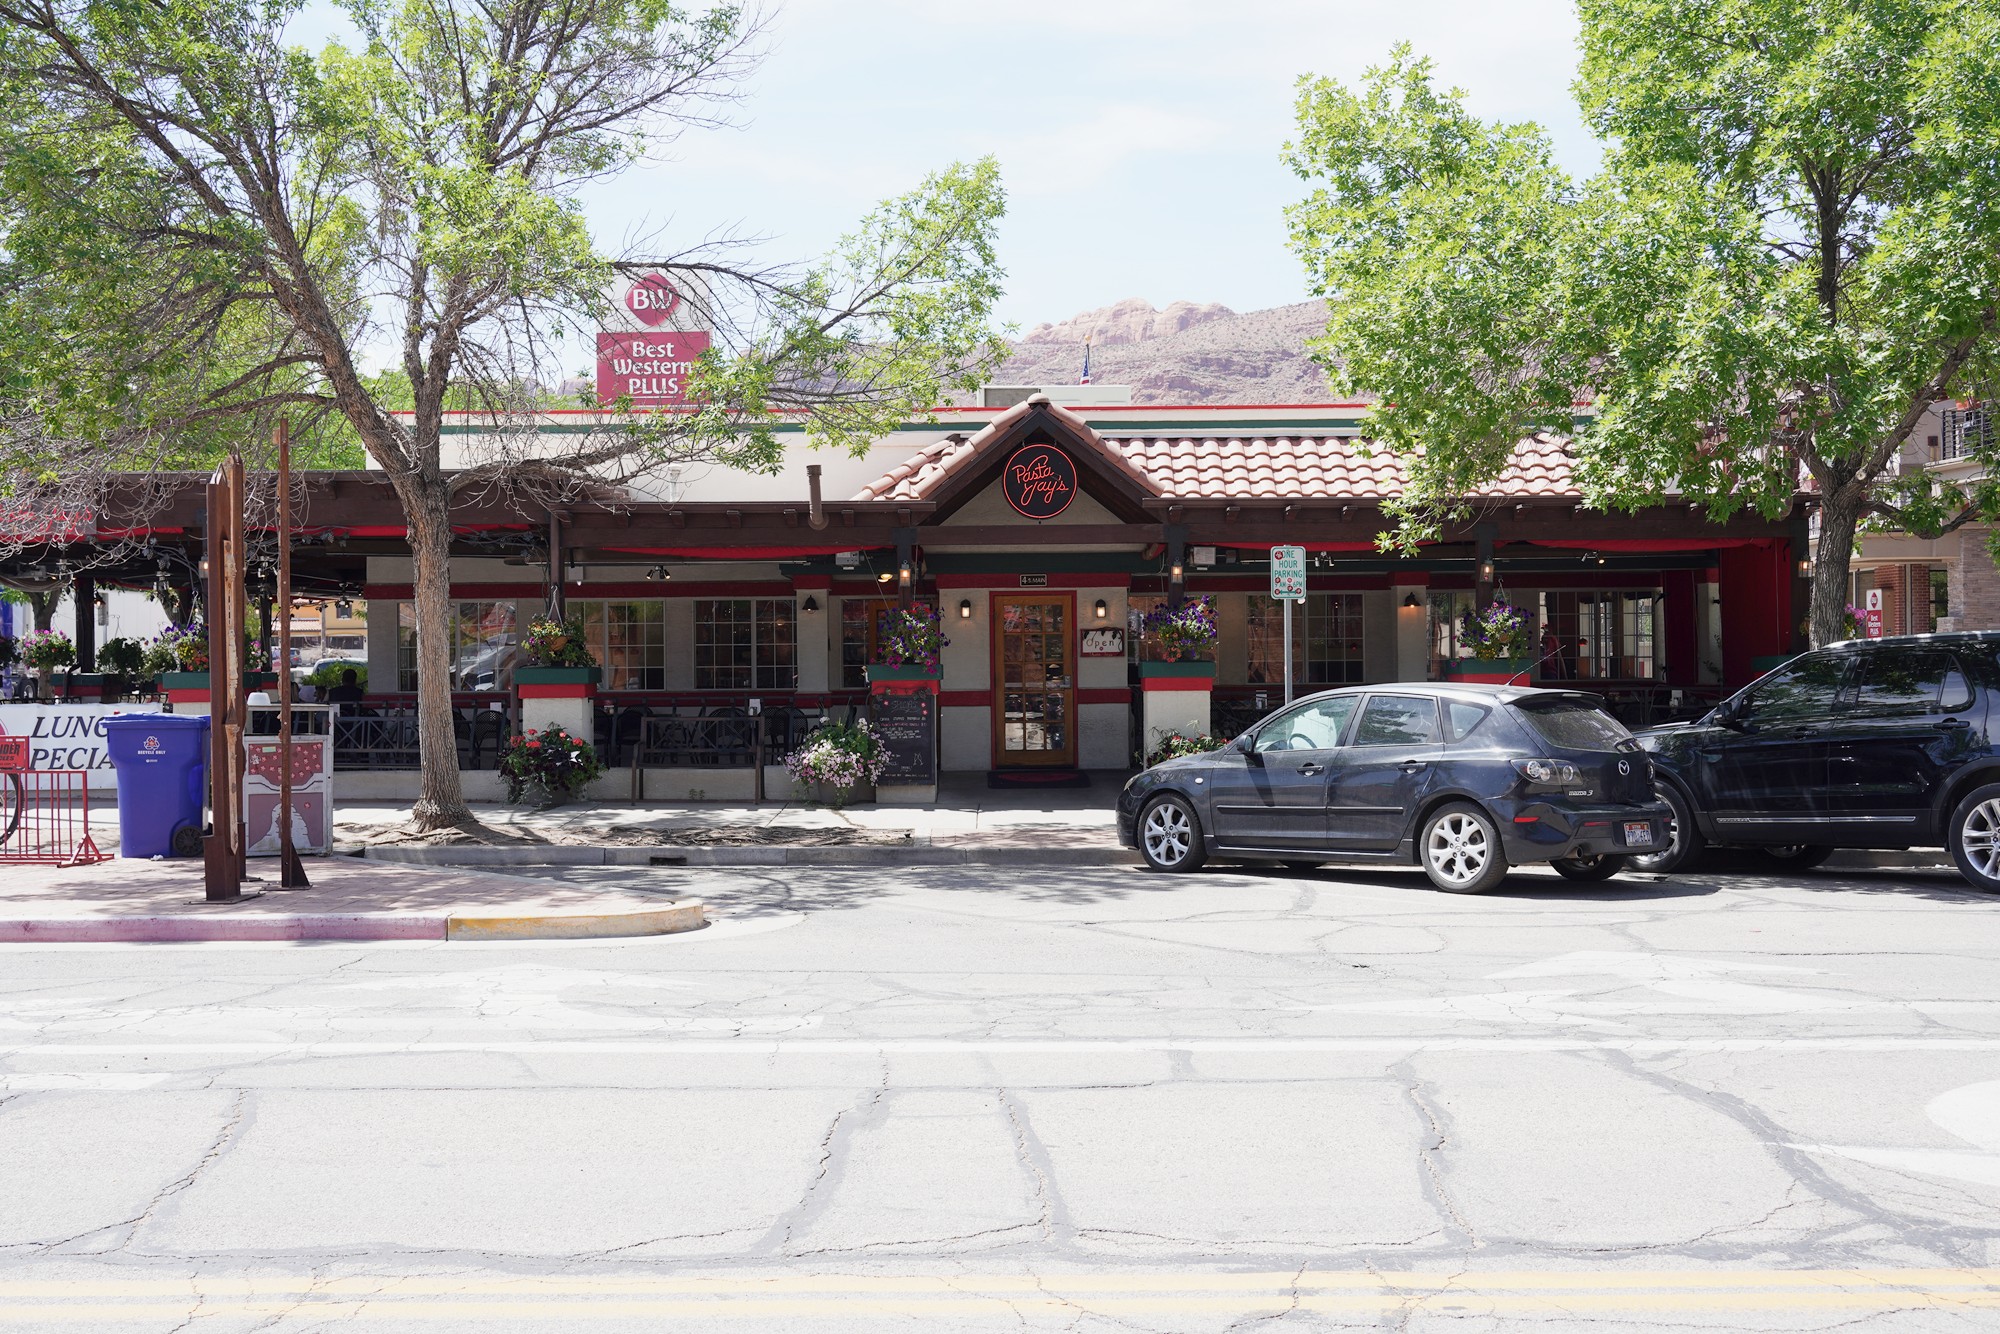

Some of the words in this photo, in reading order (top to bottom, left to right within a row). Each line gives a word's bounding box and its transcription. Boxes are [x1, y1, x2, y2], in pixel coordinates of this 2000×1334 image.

[633, 289, 673, 310] BW
[632, 341, 675, 358] Best
[613, 359, 692, 375] Western
[628, 378, 679, 394] PLUS
[1011, 455, 1055, 484] Pasta
[1281, 550, 1295, 558] ONE
[1279, 560, 1298, 568] HOUR
[1022, 576, 1027, 584] 4
[1274, 570, 1303, 578] PARKING
[1086, 638, 1115, 649] Open
